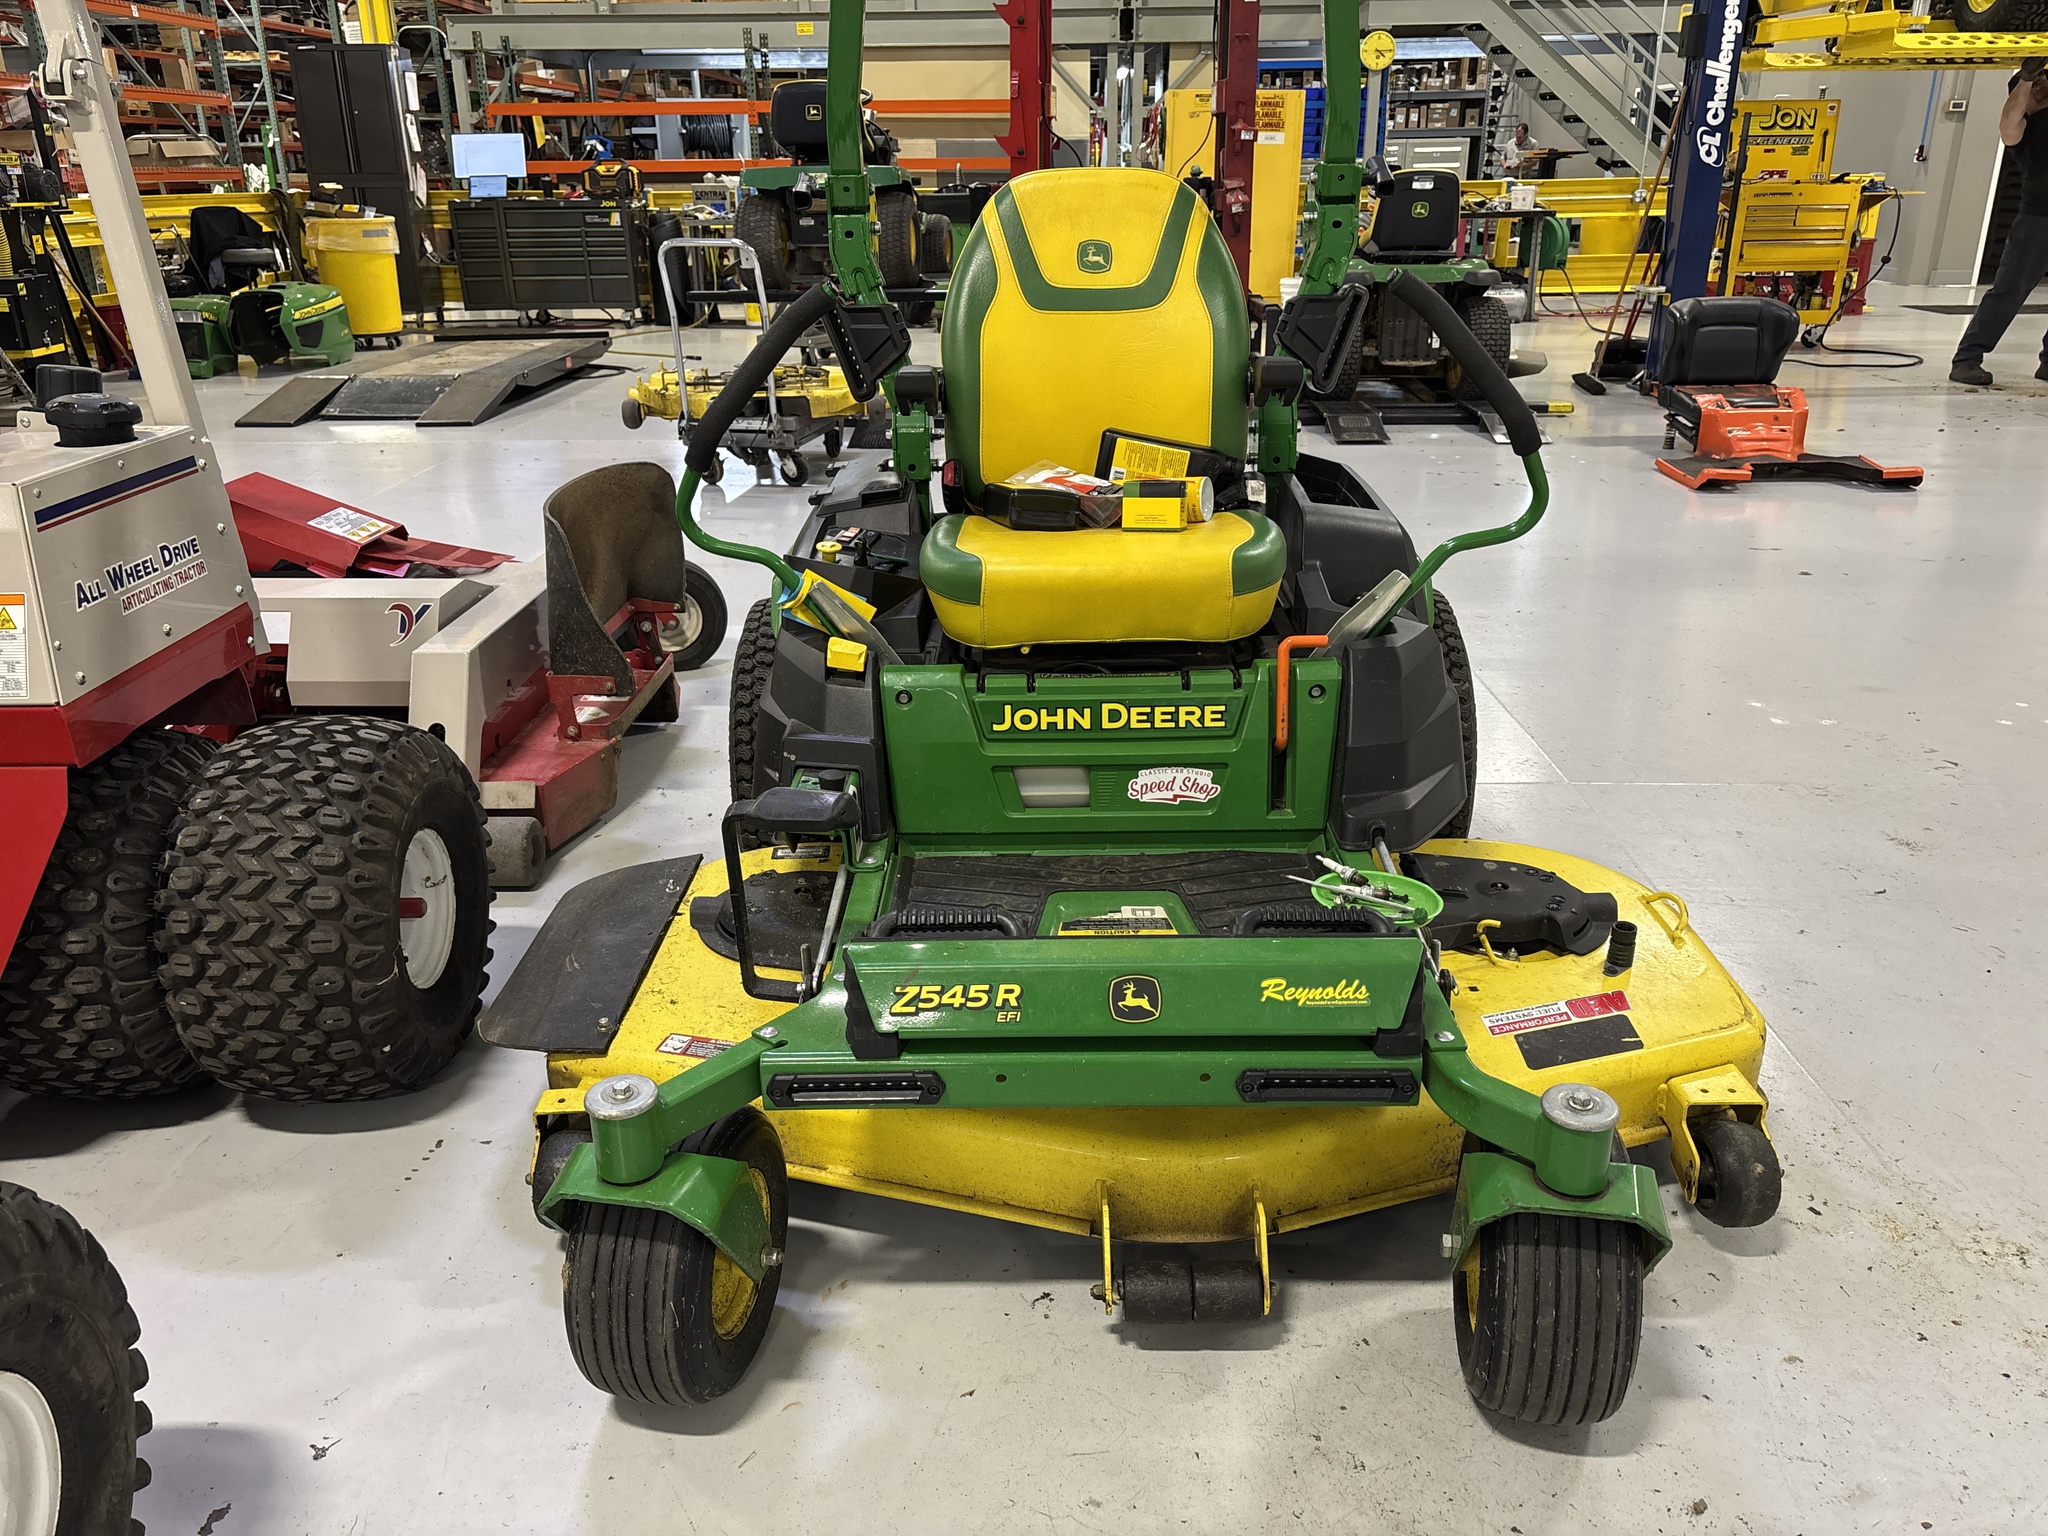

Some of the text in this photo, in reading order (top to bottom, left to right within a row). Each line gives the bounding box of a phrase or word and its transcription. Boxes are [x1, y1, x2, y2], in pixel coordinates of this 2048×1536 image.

[1759, 104, 1817, 129] JON
[76, 537, 199, 609] ALL WHEEL DRIVE
[122, 561, 206, 613] ARTICULATING TRACTOR
[992, 703, 1226, 731] JOHN DEERE
[1140, 768, 1168, 777] CLASSIC
[1186, 768, 1212, 778] STUDIO
[1129, 776, 1219, 800] Speed Shop
[890, 984, 1022, 1013] Z545 R
[1261, 978, 1370, 1006] Reynolds
[1566, 990, 1631, 1018] AED
[996, 1011, 1022, 1023] EFI
[1488, 1006, 1561, 1024] FUEL SYSTEMS
[1491, 1014, 1568, 1034] PERFORMANCE
